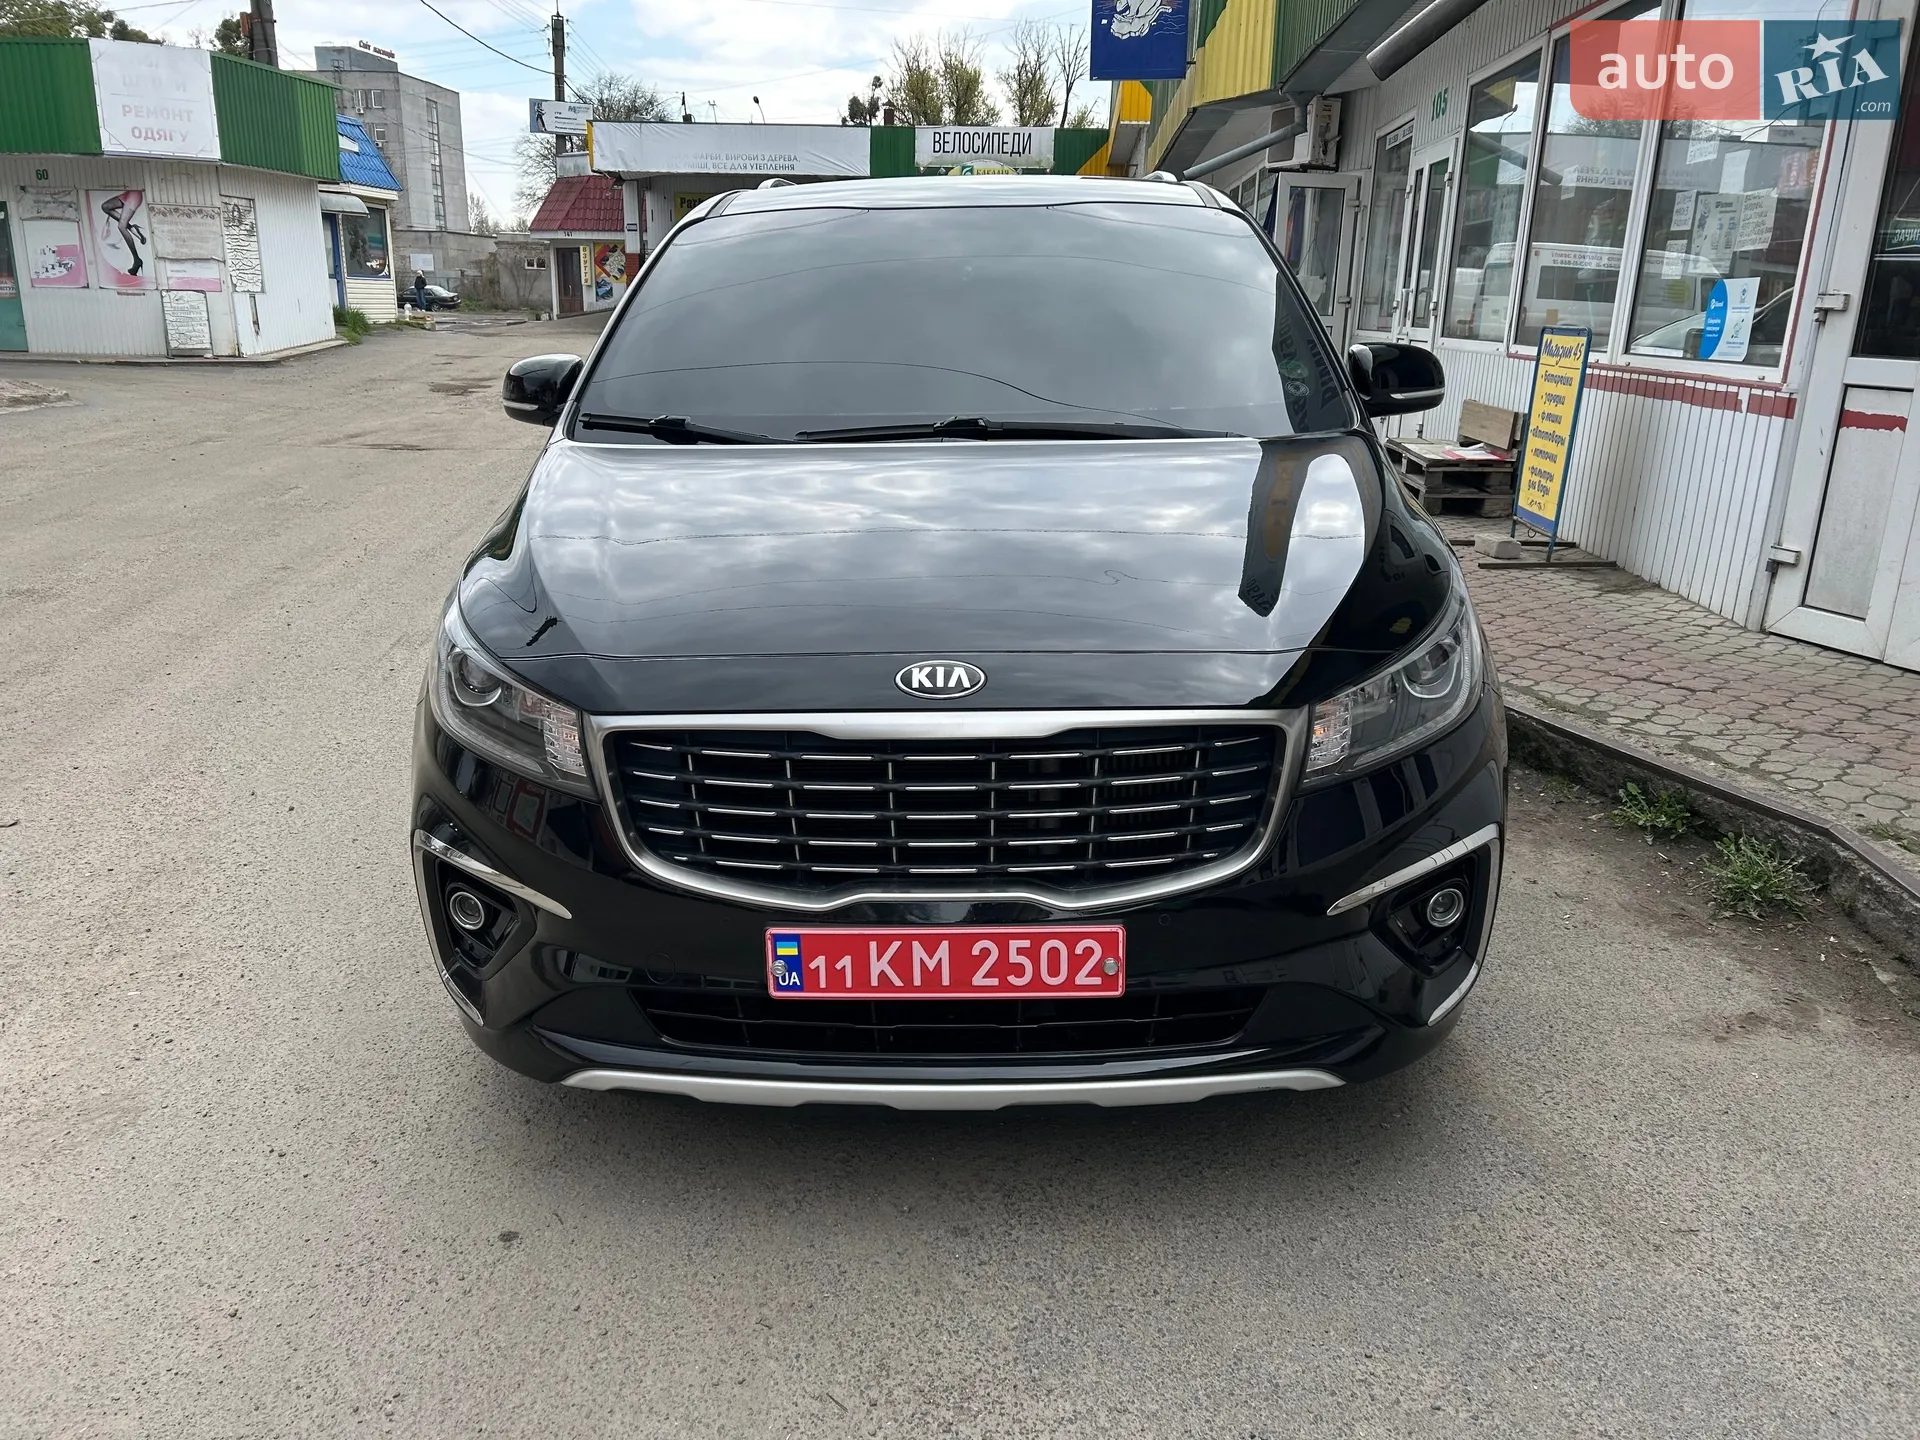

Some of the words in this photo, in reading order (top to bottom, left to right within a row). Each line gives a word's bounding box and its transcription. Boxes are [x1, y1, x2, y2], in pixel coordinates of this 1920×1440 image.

[121, 104, 194, 123] РЕМОНТ
[1431, 86, 1449, 122] 105
[131, 126, 189, 143] ОДЯГУ
[932, 131, 1032, 157] ВЕЛОСИПЕДИ
[712, 162, 728, 170] ВСЕ
[729, 162, 747, 171] ДЛЯ
[748, 162, 796, 171] УТЕПЛЕННЯ
[725, 153, 759, 162] ВИРОБИ
[767, 154, 801, 164] ДЕРЕВА,
[35, 169, 49, 181] 60
[1542, 337, 1574, 367] Магазин
[1573, 342, 1585, 362] 45
[911, 666, 971, 688] KIA
[807, 954, 853, 989] 11
[868, 939, 951, 988] KM
[970, 938, 1104, 988] 2502
[778, 971, 801, 987] UA
